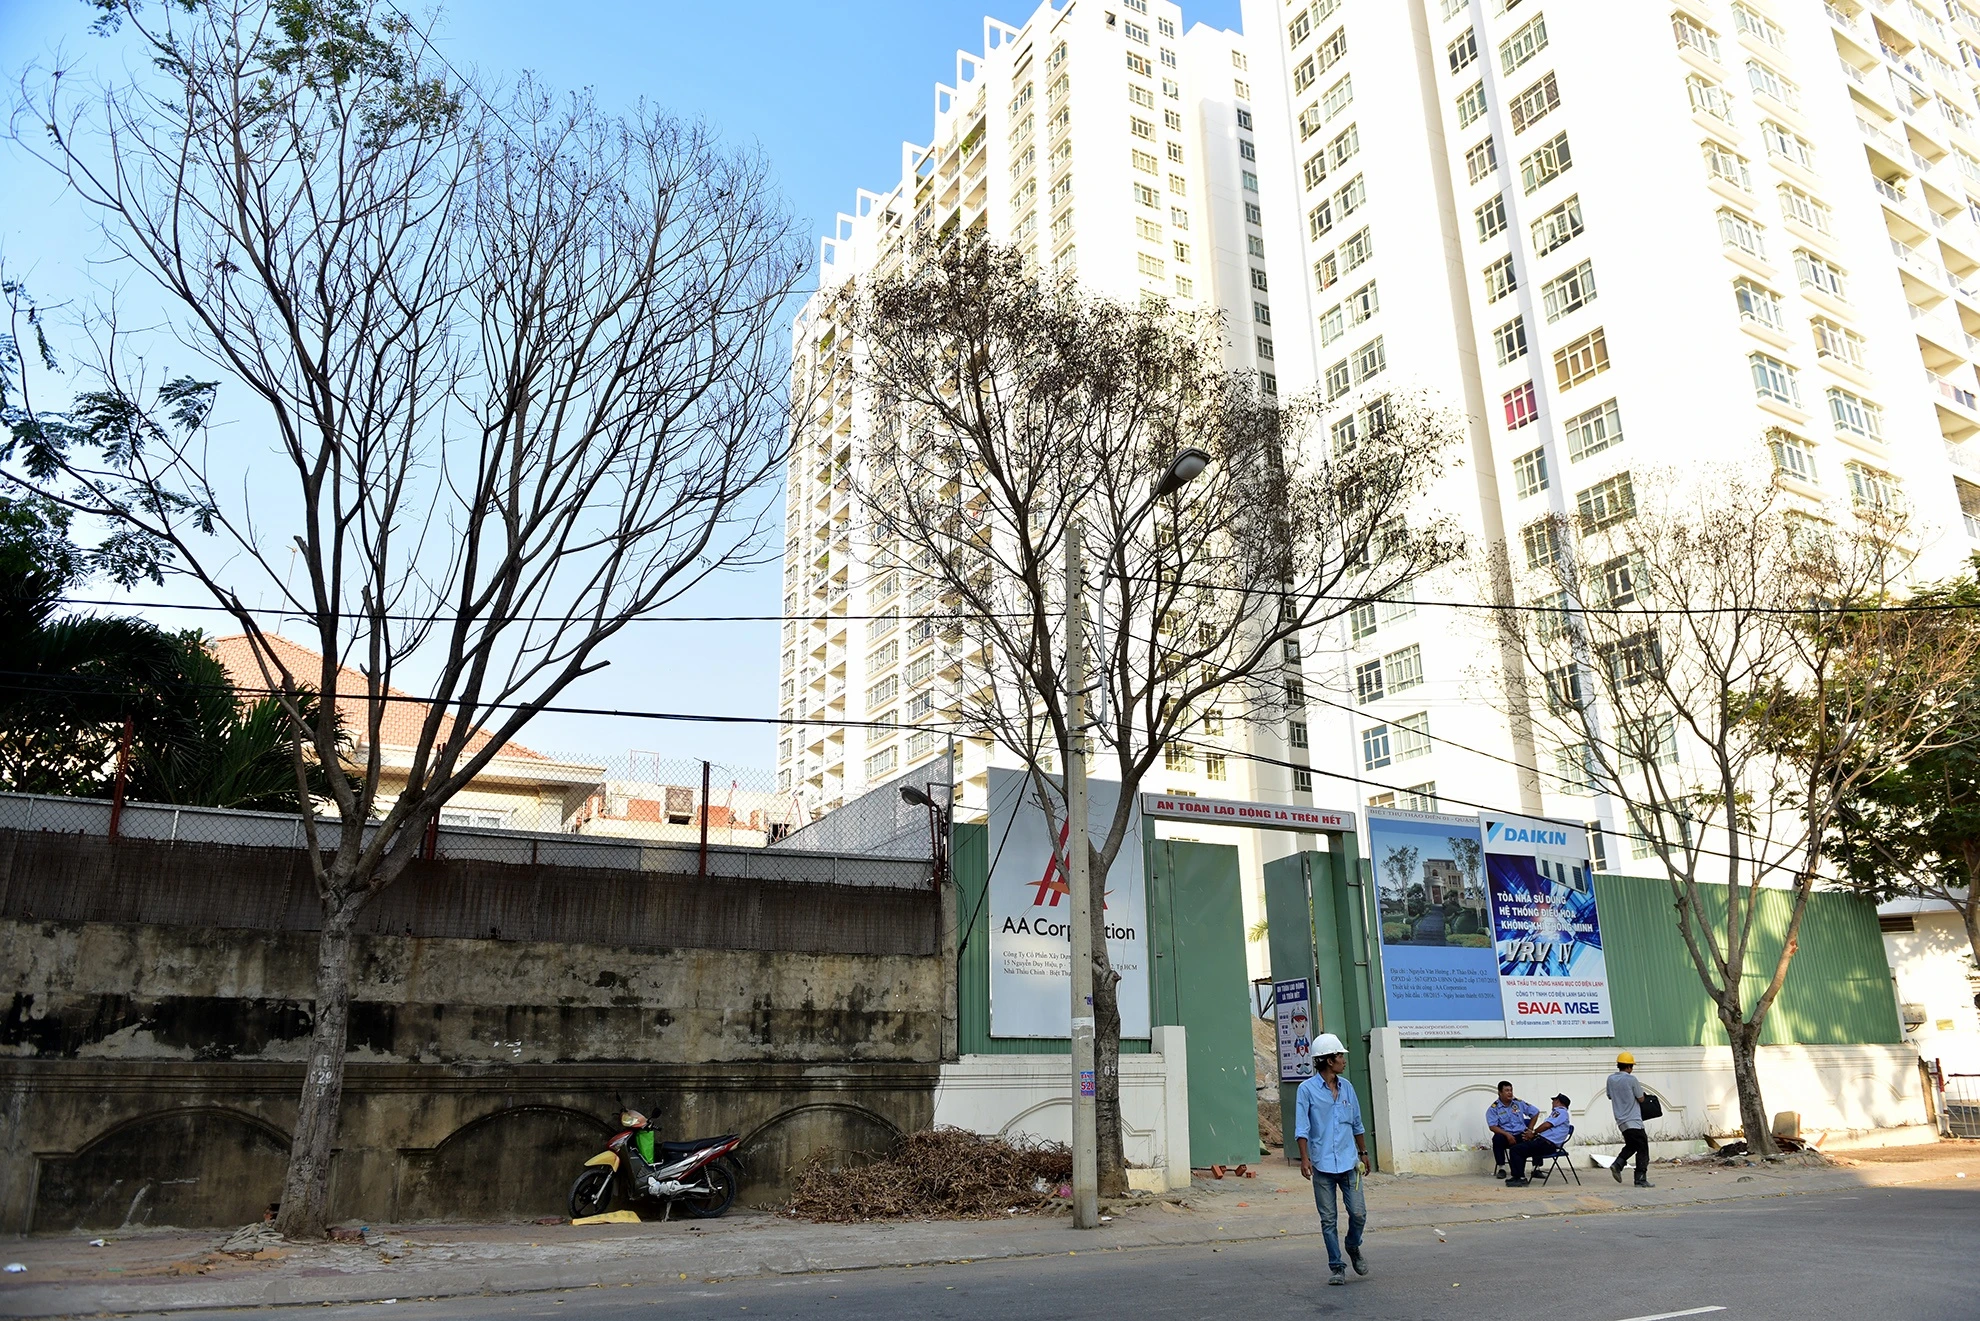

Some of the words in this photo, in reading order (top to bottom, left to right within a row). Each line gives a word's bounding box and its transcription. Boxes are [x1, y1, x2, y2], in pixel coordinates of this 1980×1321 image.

[1157, 801, 1174, 810] AN
[1178, 802, 1210, 813] TOÀN
[1214, 805, 1235, 815] LAO
[1239, 807, 1271, 819] ĐỘNG
[1275, 810, 1288, 820] LÀ
[1291, 812, 1318, 823] TRÊN
[1322, 814, 1341, 825] HẾT
[1505, 828, 1566, 845] DAIKIN
[1533, 892, 1544, 903] SỬ
[1499, 905, 1510, 918] HỆ
[1512, 904, 1539, 917] THỐNG
[1002, 916, 1031, 935] AA
[1501, 919, 1529, 930] KHÔNG
[1574, 923, 1593, 932] MINH
[1505, 941, 1552, 962] VRV
[1012, 959, 1031, 967] Nguyễn
[1518, 1002, 1562, 1014] SAVA
[1564, 1002, 1600, 1014] M&E
